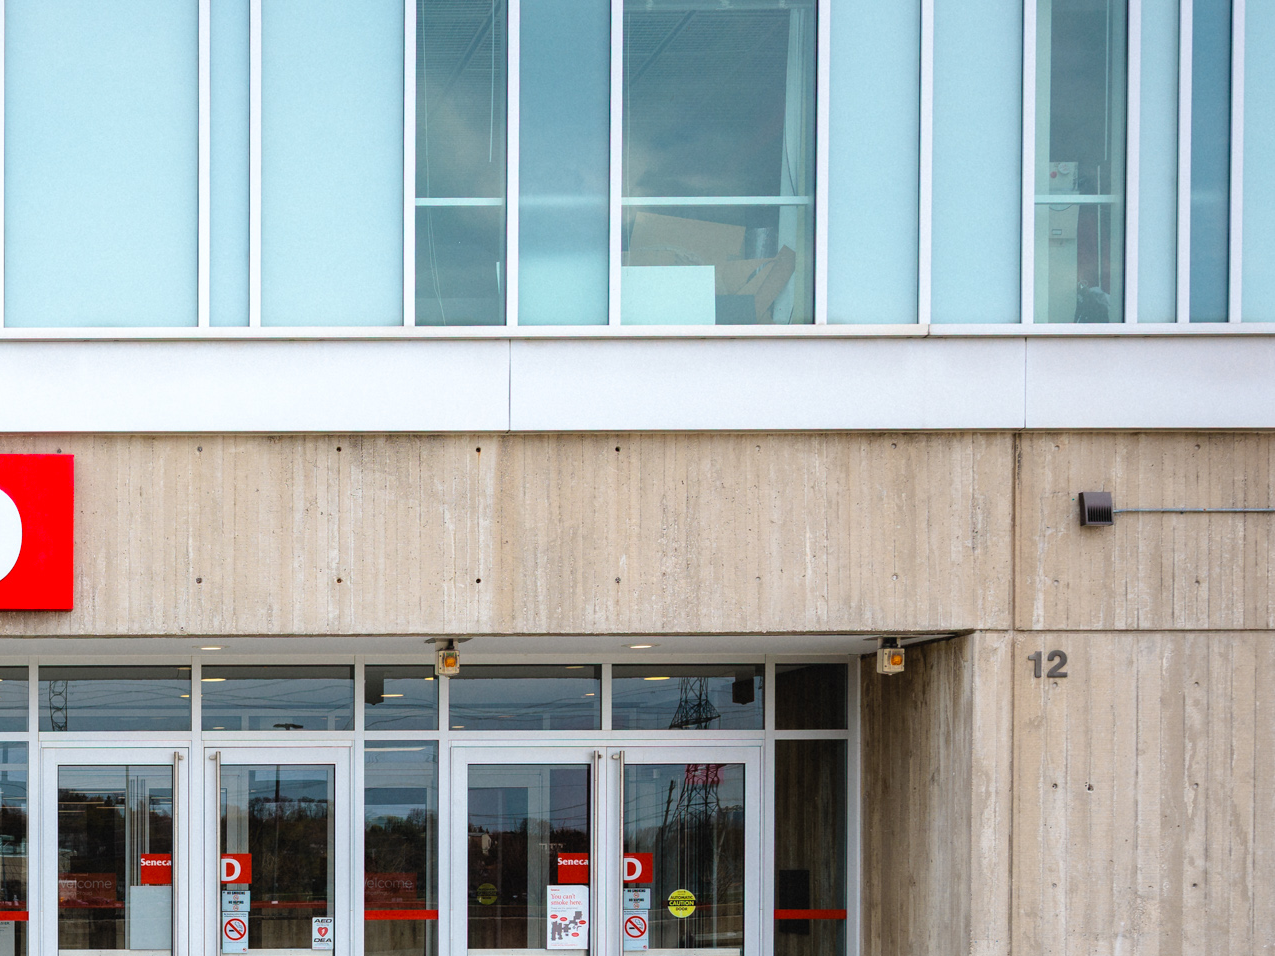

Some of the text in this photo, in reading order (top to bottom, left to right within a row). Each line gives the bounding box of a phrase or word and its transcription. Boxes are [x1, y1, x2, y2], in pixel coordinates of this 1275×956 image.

[1027, 650, 1067, 678] 12
[140, 857, 172, 867] Seneca
[221, 858, 241, 882] D
[557, 856, 589, 866] Seneca
[623, 857, 643, 881] D
[365, 877, 414, 889] elcome
